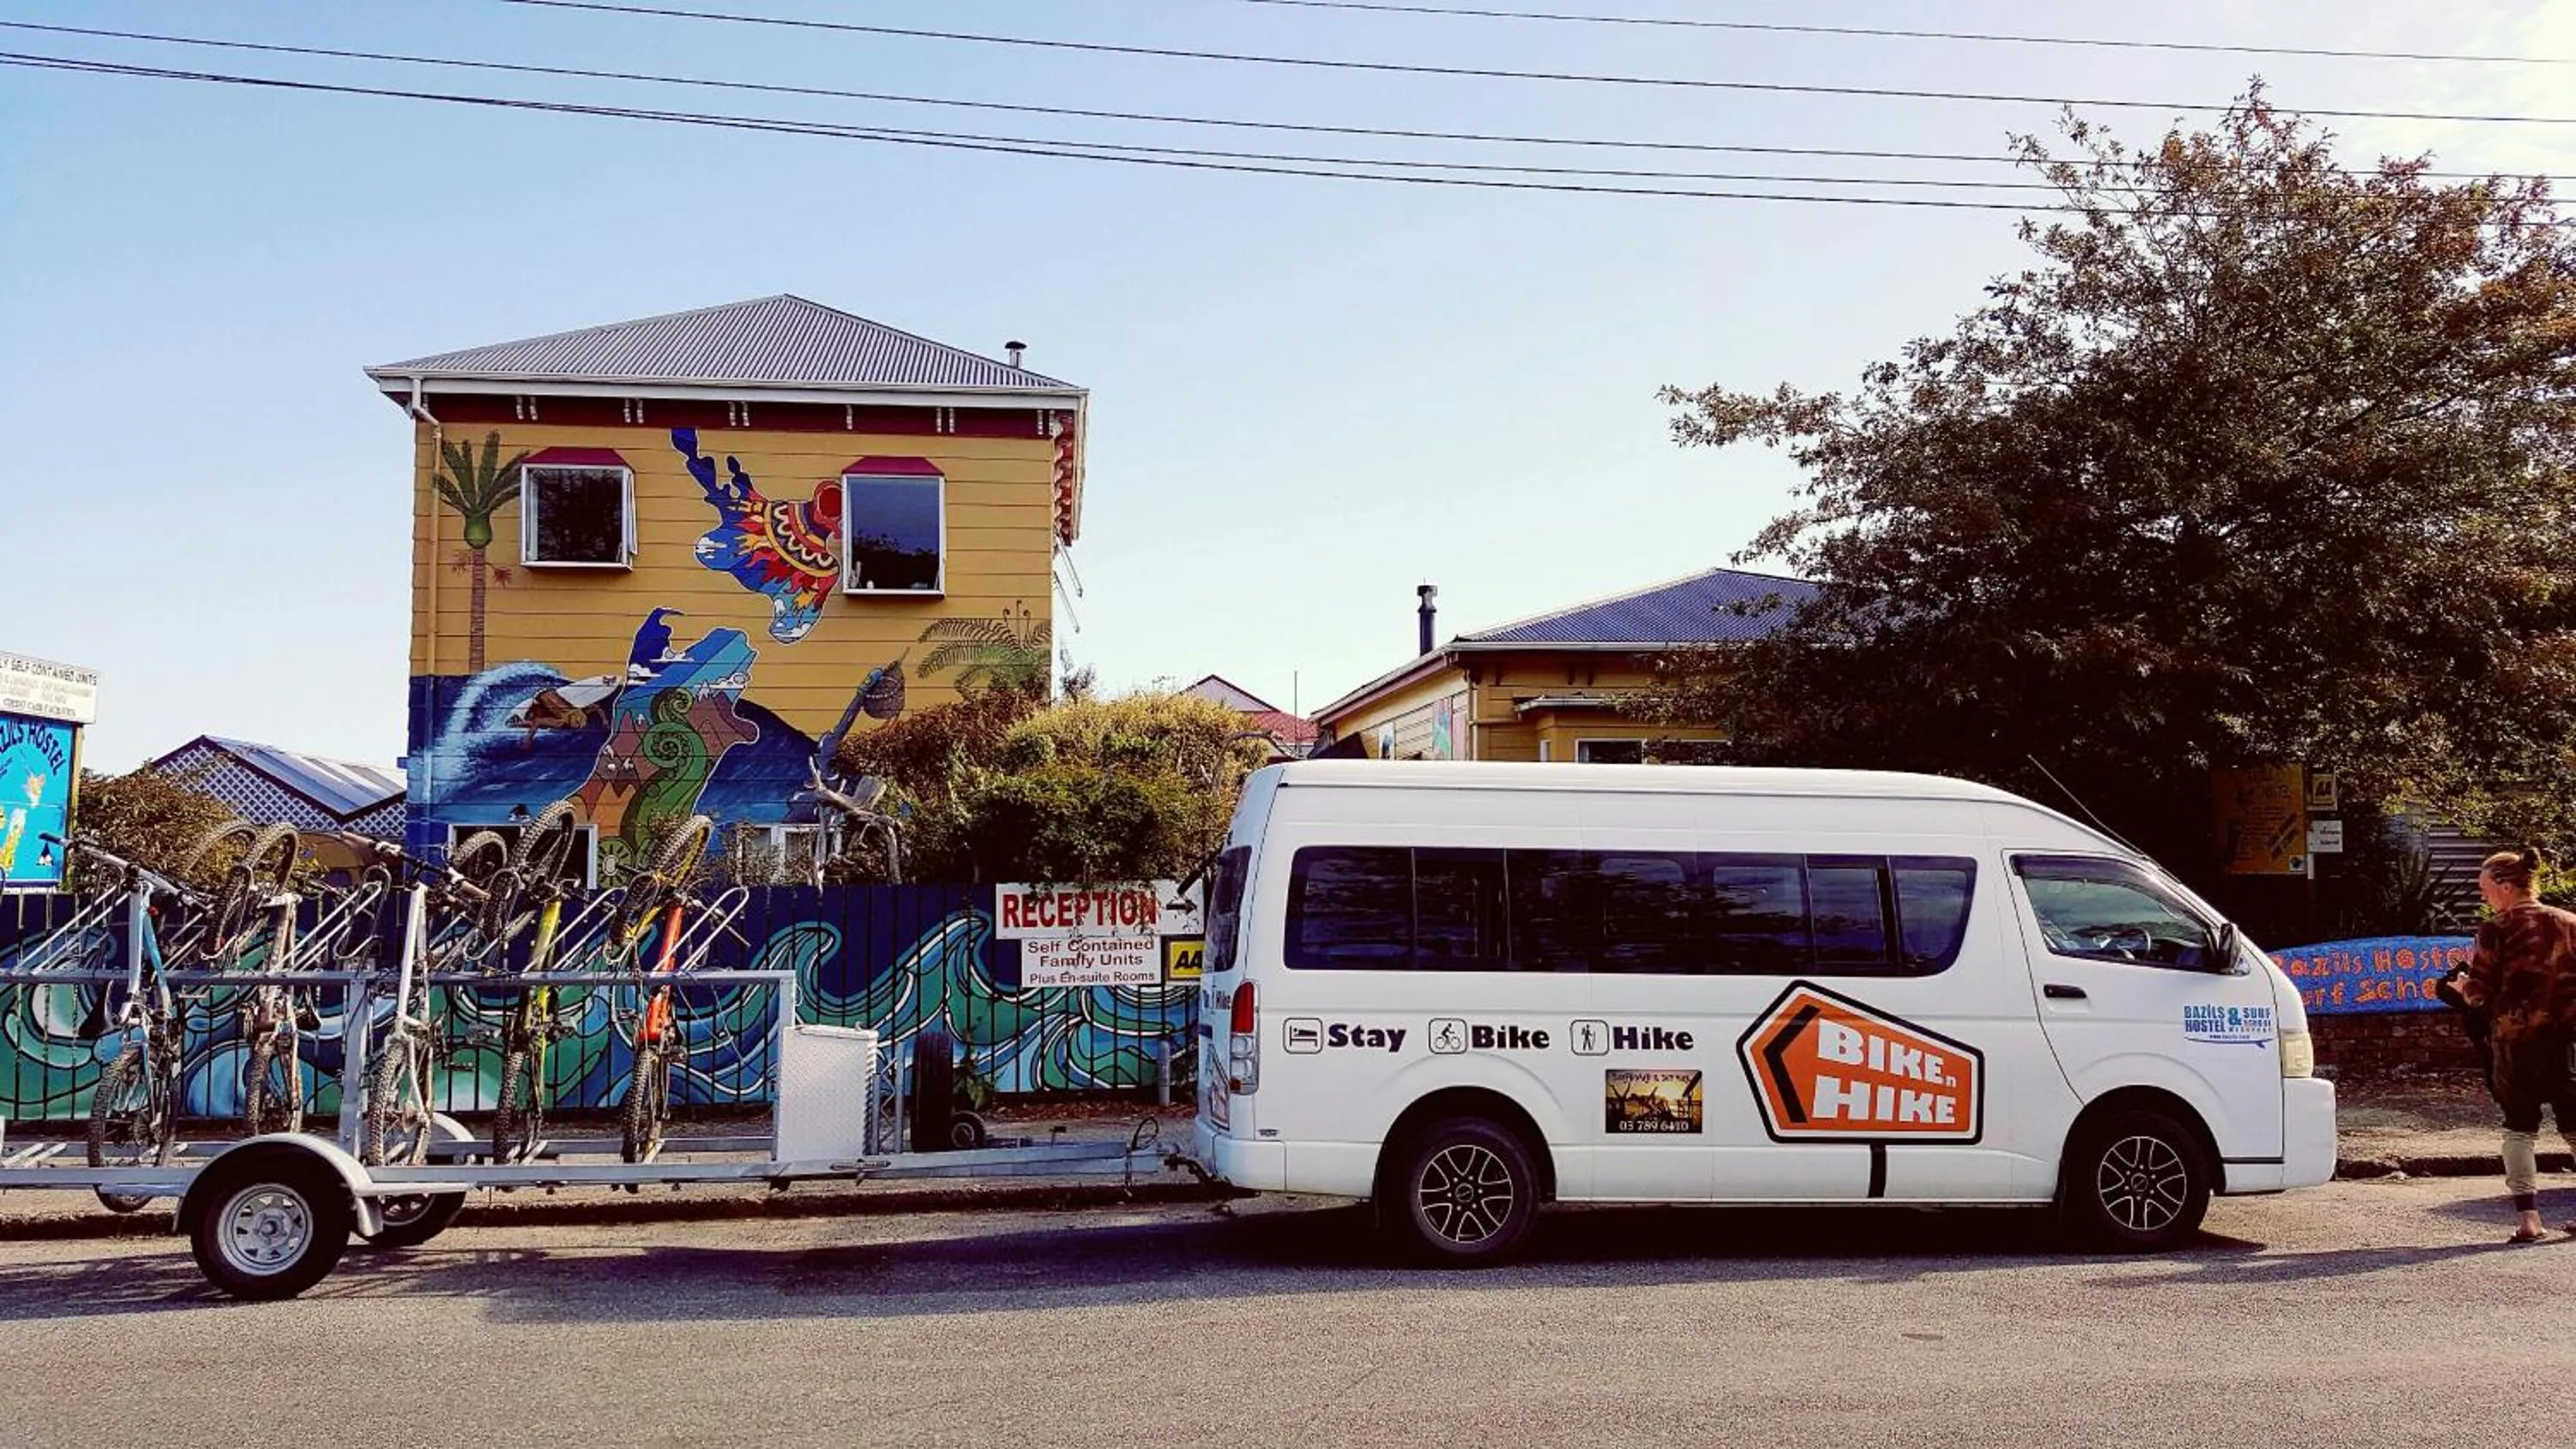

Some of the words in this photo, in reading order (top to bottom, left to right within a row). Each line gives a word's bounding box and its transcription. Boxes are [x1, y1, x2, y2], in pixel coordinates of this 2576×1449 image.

[27, 719, 66, 776] HOSTEL
[1002, 893, 1157, 928] RECEPTION
[1028, 940, 1061, 954] Self
[1067, 939, 1155, 953] Contained
[1040, 955, 1095, 968] Family
[1100, 953, 1144, 966] Units
[1174, 950, 1203, 969] AA
[1030, 973, 1056, 985] Plus
[1114, 971, 1156, 983] Rooms
[2227, 1008, 2242, 1026] &
[2243, 1007, 2271, 1019] SURF
[1471, 1024, 1551, 1050] Bike
[2184, 1019, 2227, 1033] HOSTEL
[1327, 1023, 1407, 1053] Stay
[1613, 1026, 1694, 1051] Hike
[1818, 1017, 1945, 1086] BIKE
[1813, 1075, 1957, 1124] HIKE
